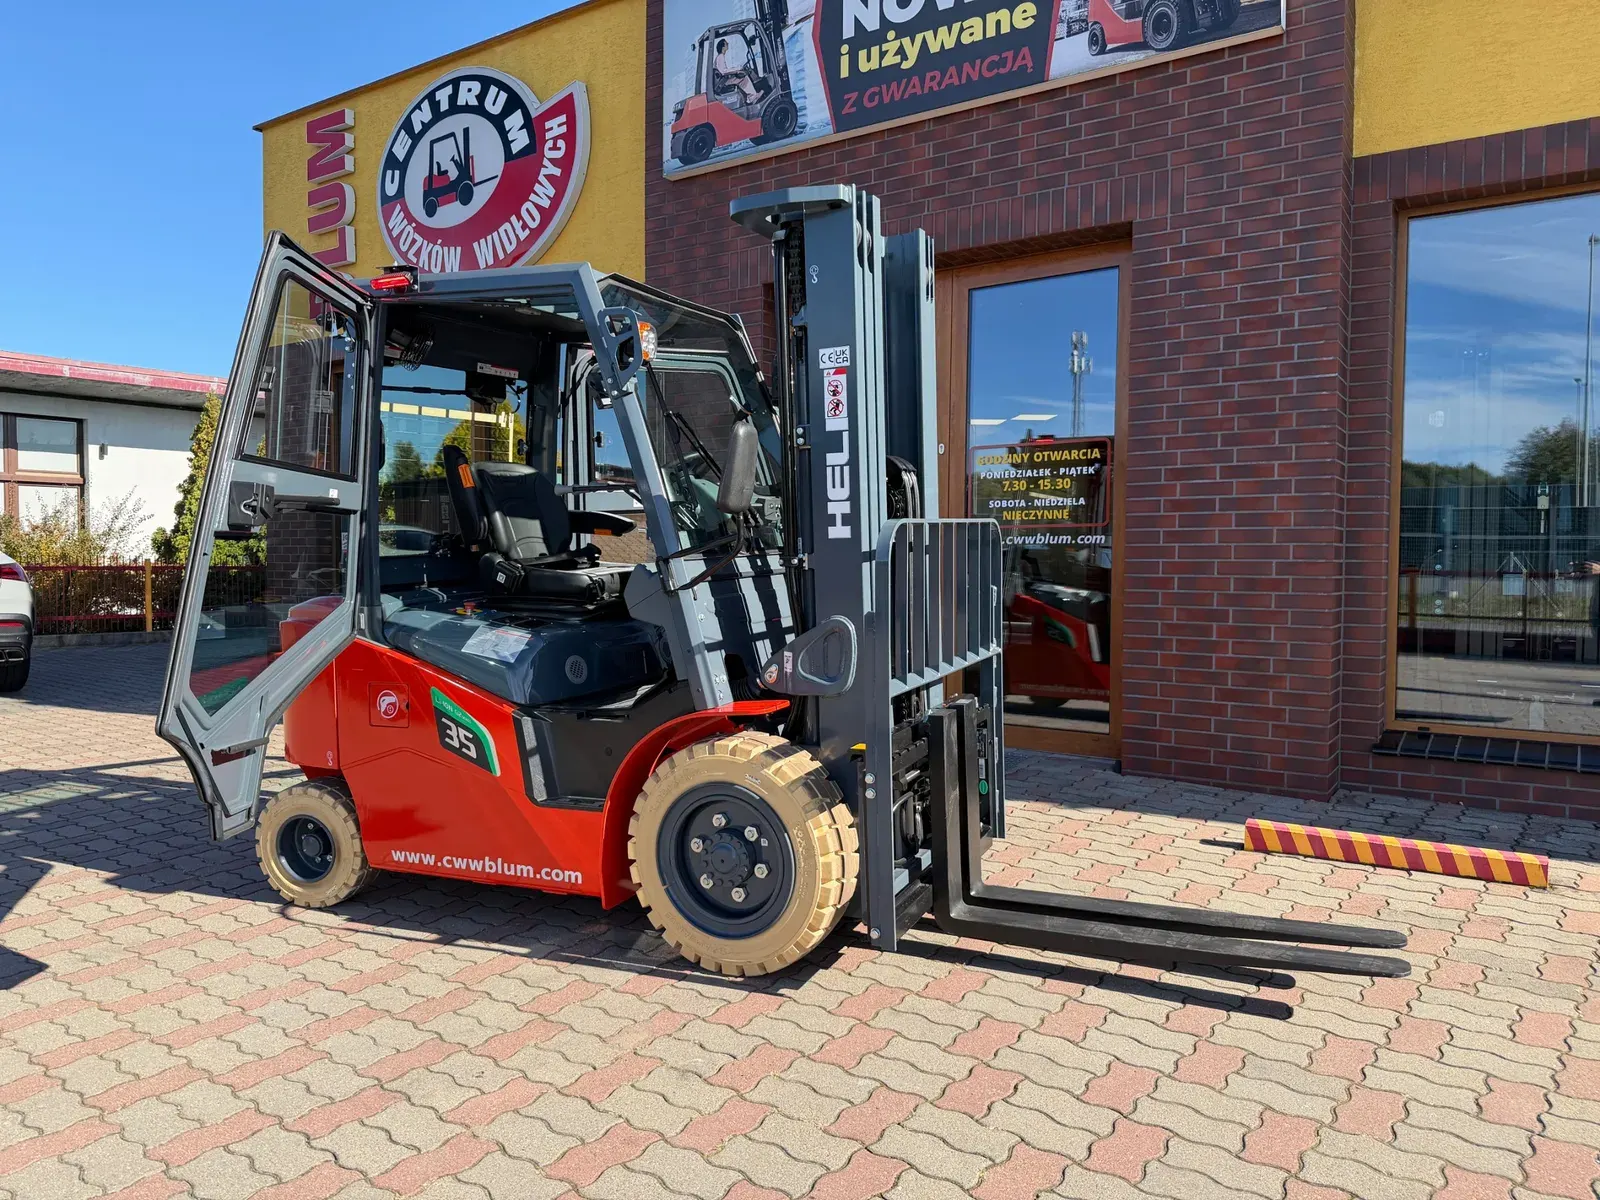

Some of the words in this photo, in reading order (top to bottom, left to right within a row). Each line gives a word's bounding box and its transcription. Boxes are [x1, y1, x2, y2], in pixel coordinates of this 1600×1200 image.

[840, 44, 849, 79] i
[858, 1, 1037, 72] używane
[841, 92, 858, 115] Z
[862, 46, 1034, 109] GWARANCJĄ
[384, 80, 531, 197] CENTRUM
[387, 205, 462, 274] WÓZKÓW
[473, 113, 568, 270] WIDŁOWYCH
[977, 452, 1031, 466] GODZINY
[1033, 448, 1101, 463] OTWARCIA
[980, 468, 1051, 479] PONIEDZIAŁEK
[1059, 466, 1095, 478] PIĄTEK
[827, 418, 851, 538] HELI
[1002, 480, 1027, 492] 7.30
[1038, 478, 1071, 490] 15.30
[988, 499, 1026, 508] SOBOTA
[1034, 497, 1086, 507] NIEDZIELA
[1002, 509, 1070, 521] NIECZYNNE
[441, 717, 477, 759] 35
[390, 849, 583, 884] www.cwwblum.com
